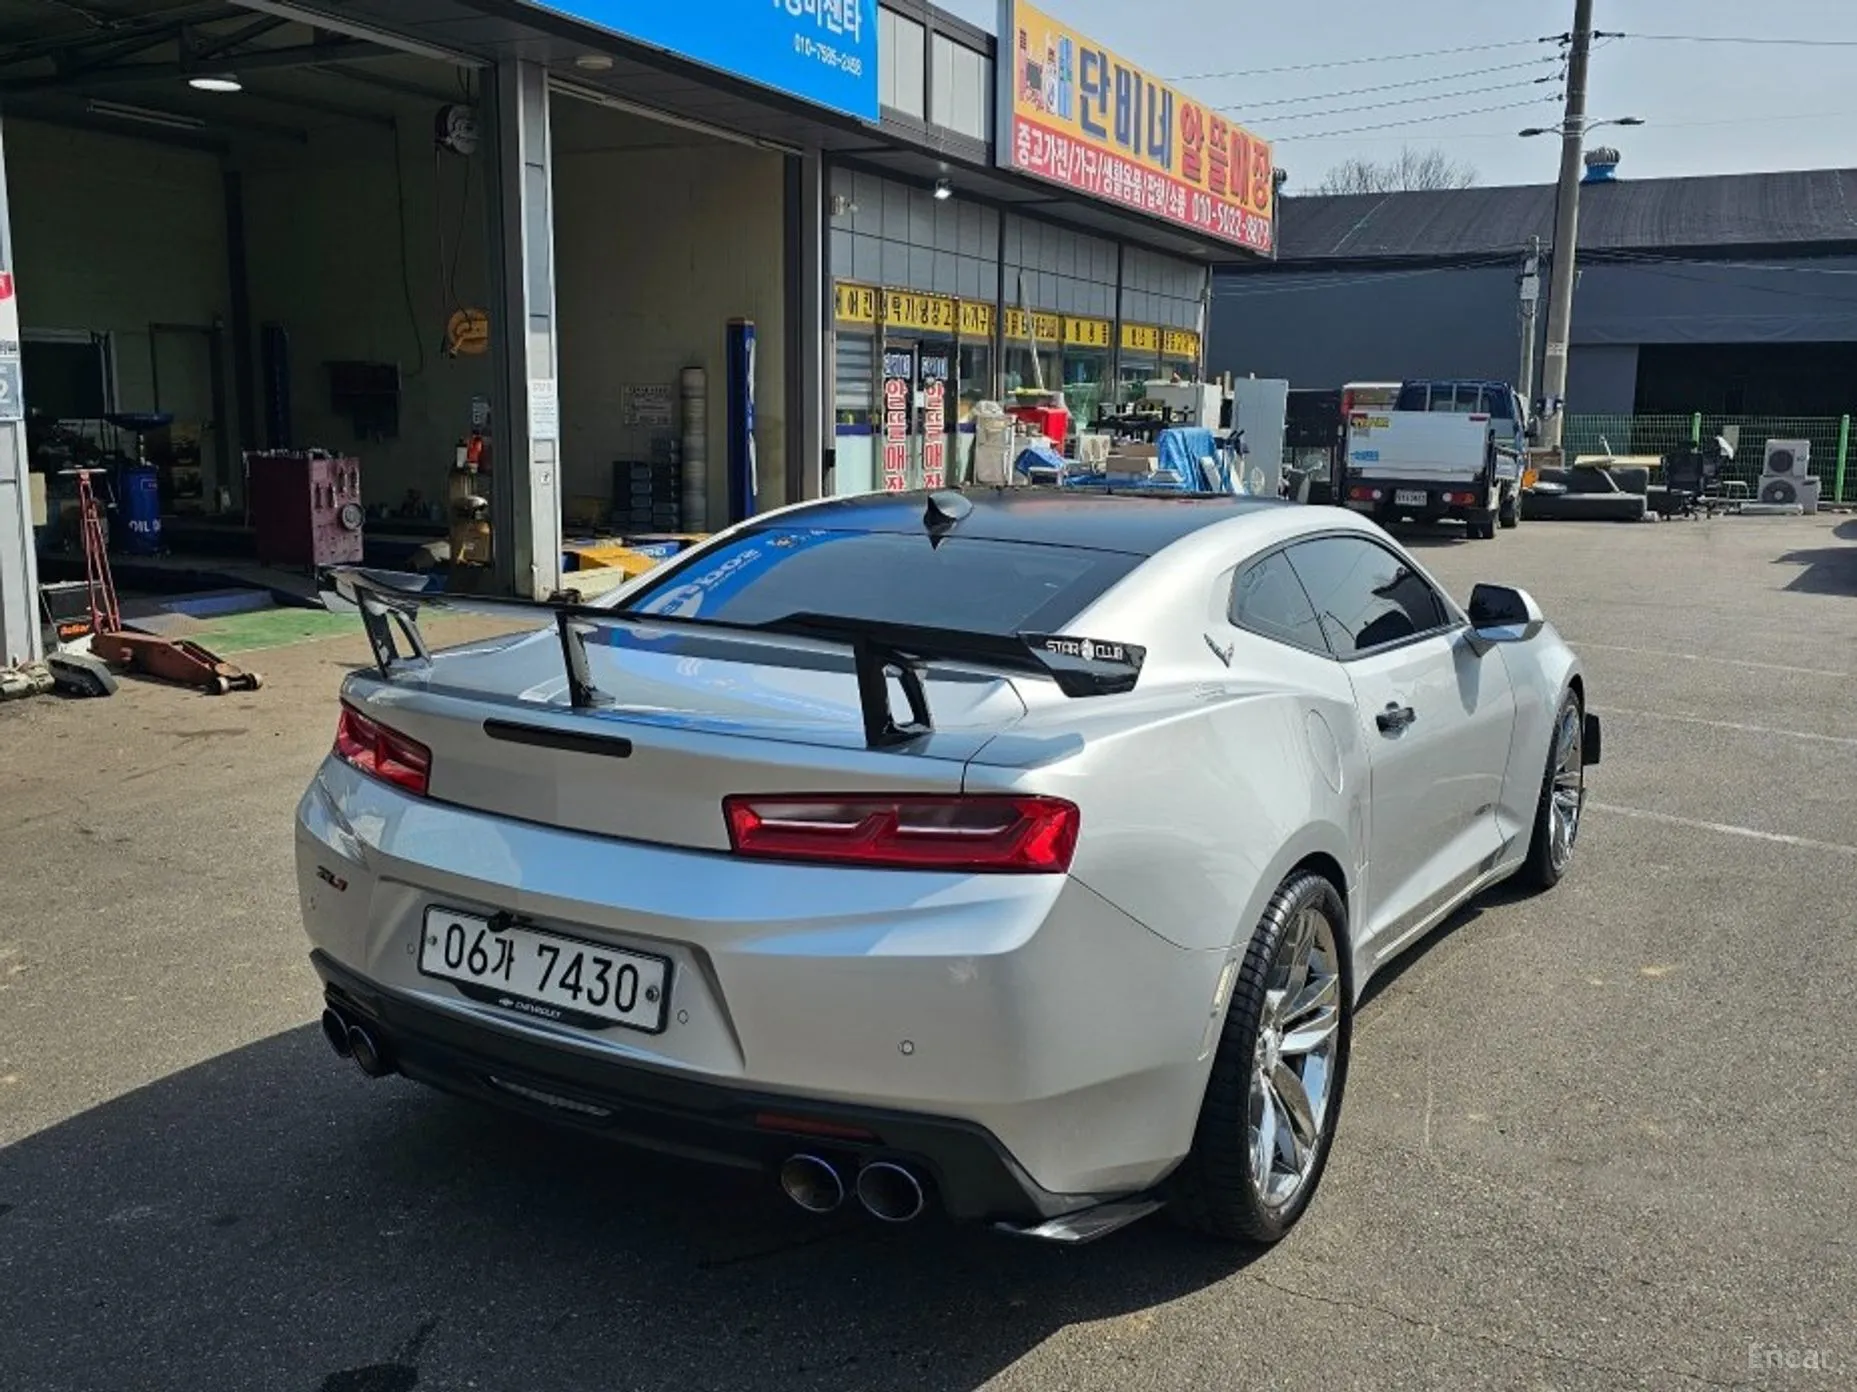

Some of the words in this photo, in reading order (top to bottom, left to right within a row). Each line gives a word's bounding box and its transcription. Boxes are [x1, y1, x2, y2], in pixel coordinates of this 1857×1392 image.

[1079, 47, 1173, 170] 단비네
[1180, 102, 1271, 211] 알뜰매장
[1046, 640, 1079, 655] STAR
[444, 922, 516, 981] 06가
[536, 943, 639, 1013] 7430
